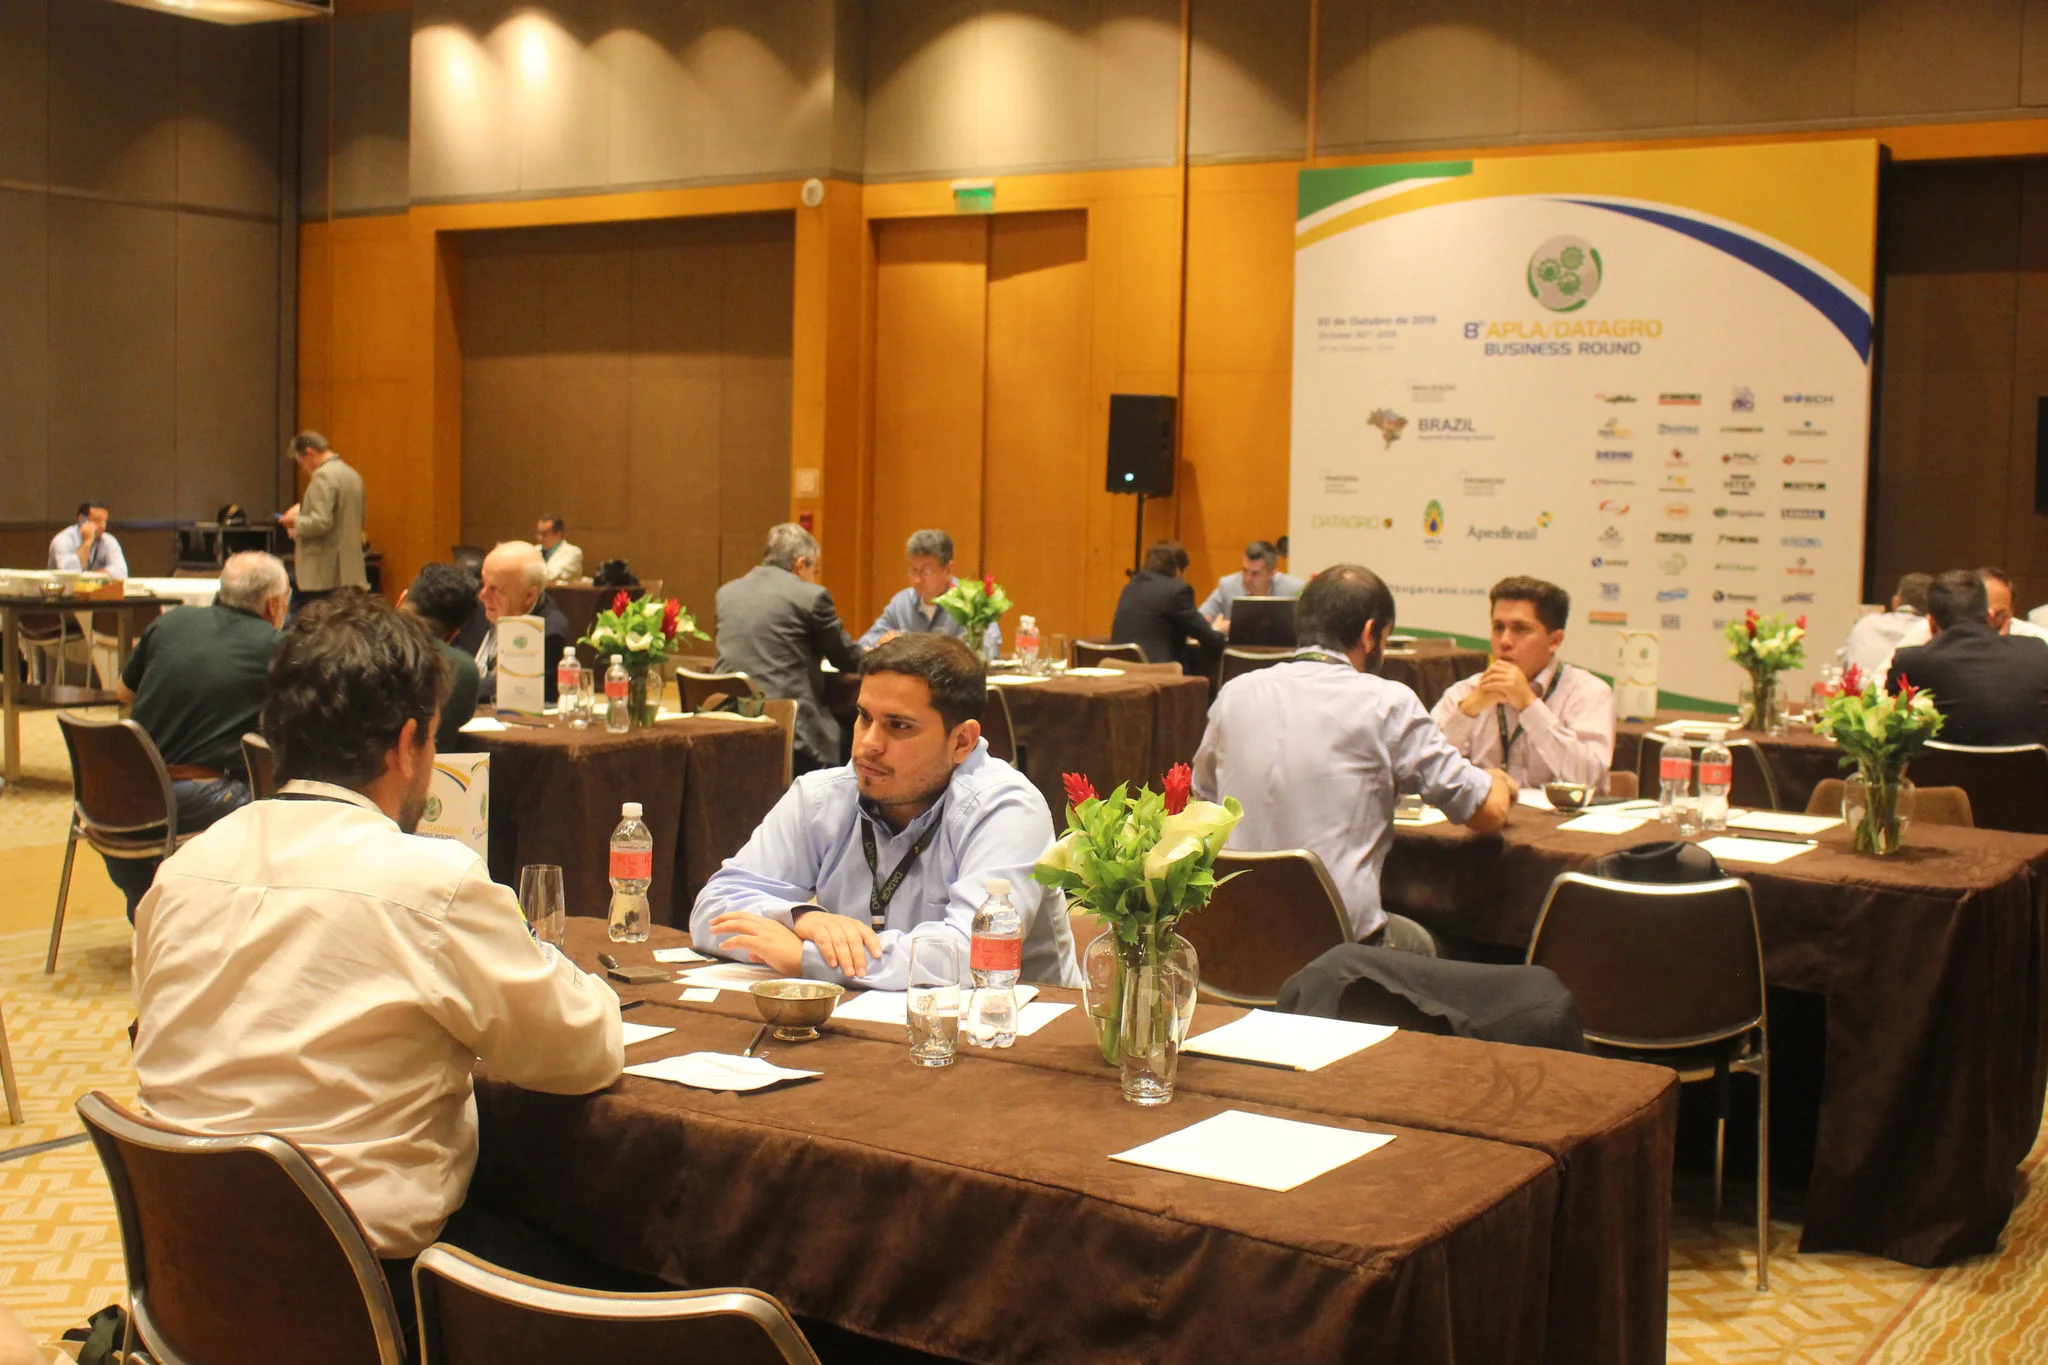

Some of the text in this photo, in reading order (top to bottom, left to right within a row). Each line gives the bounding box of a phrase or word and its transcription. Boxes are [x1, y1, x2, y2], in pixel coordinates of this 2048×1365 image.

[1484, 341, 1641, 356] BUSINESS ROUND
[1418, 417, 1476, 432] BRAZIL
[1311, 513, 1380, 530] DATAGRO
[1466, 525, 1538, 542] ApexBrasil
